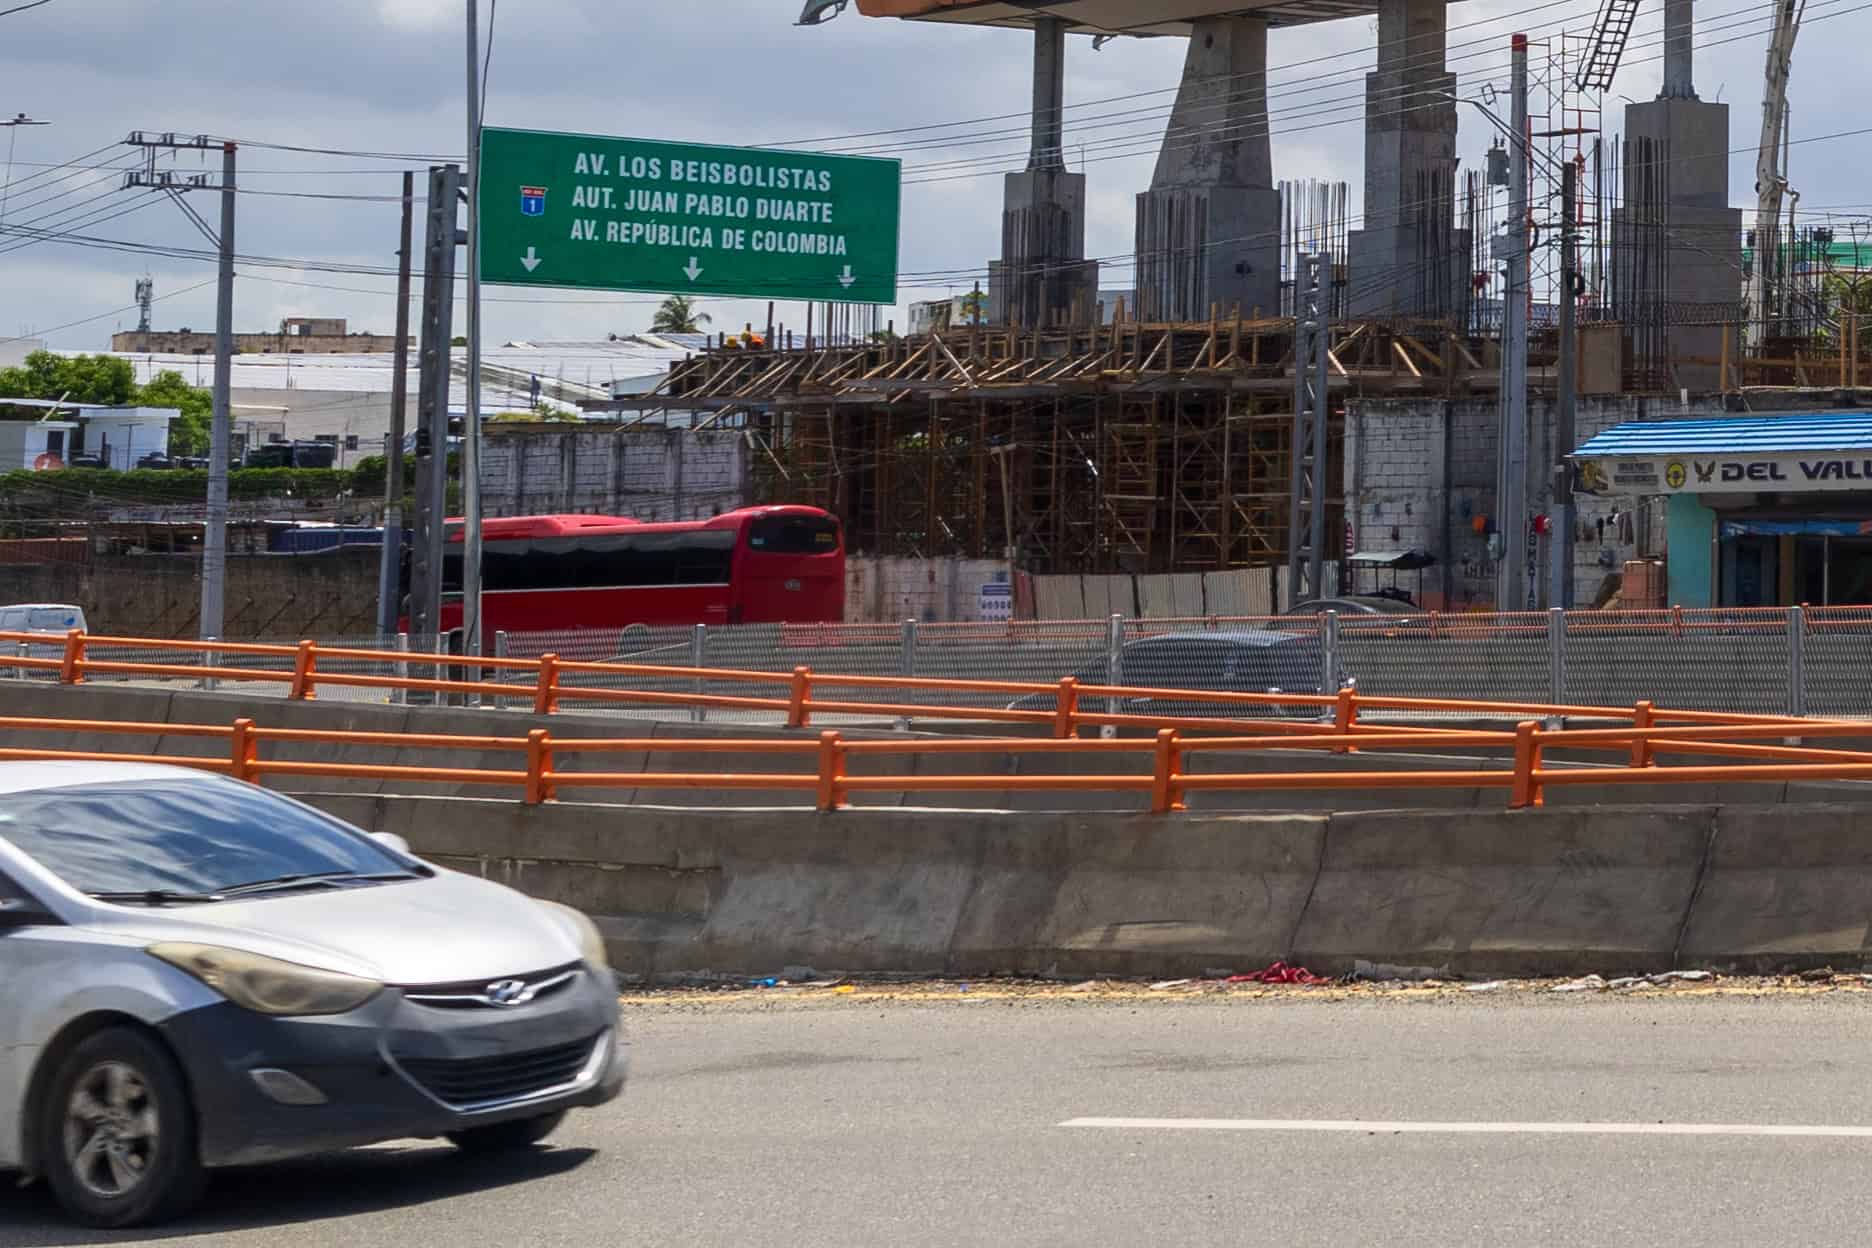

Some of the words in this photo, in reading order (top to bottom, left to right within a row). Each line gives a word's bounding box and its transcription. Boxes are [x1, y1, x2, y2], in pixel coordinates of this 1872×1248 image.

[574, 152, 609, 178] AV.
[619, 156, 661, 180] LOS
[670, 160, 831, 192] BEISBOLISTAS
[572, 186, 617, 210] AUT.
[624, 189, 678, 214] JUAN
[685, 194, 749, 218] PABLO
[756, 199, 833, 223] DUARTE
[570, 219, 599, 241] AV.
[606, 219, 713, 249] REPÚBLICA
[722, 229, 744, 250] DE
[752, 231, 847, 256] COLOMBIA
[1721, 461, 1787, 482] DEL
